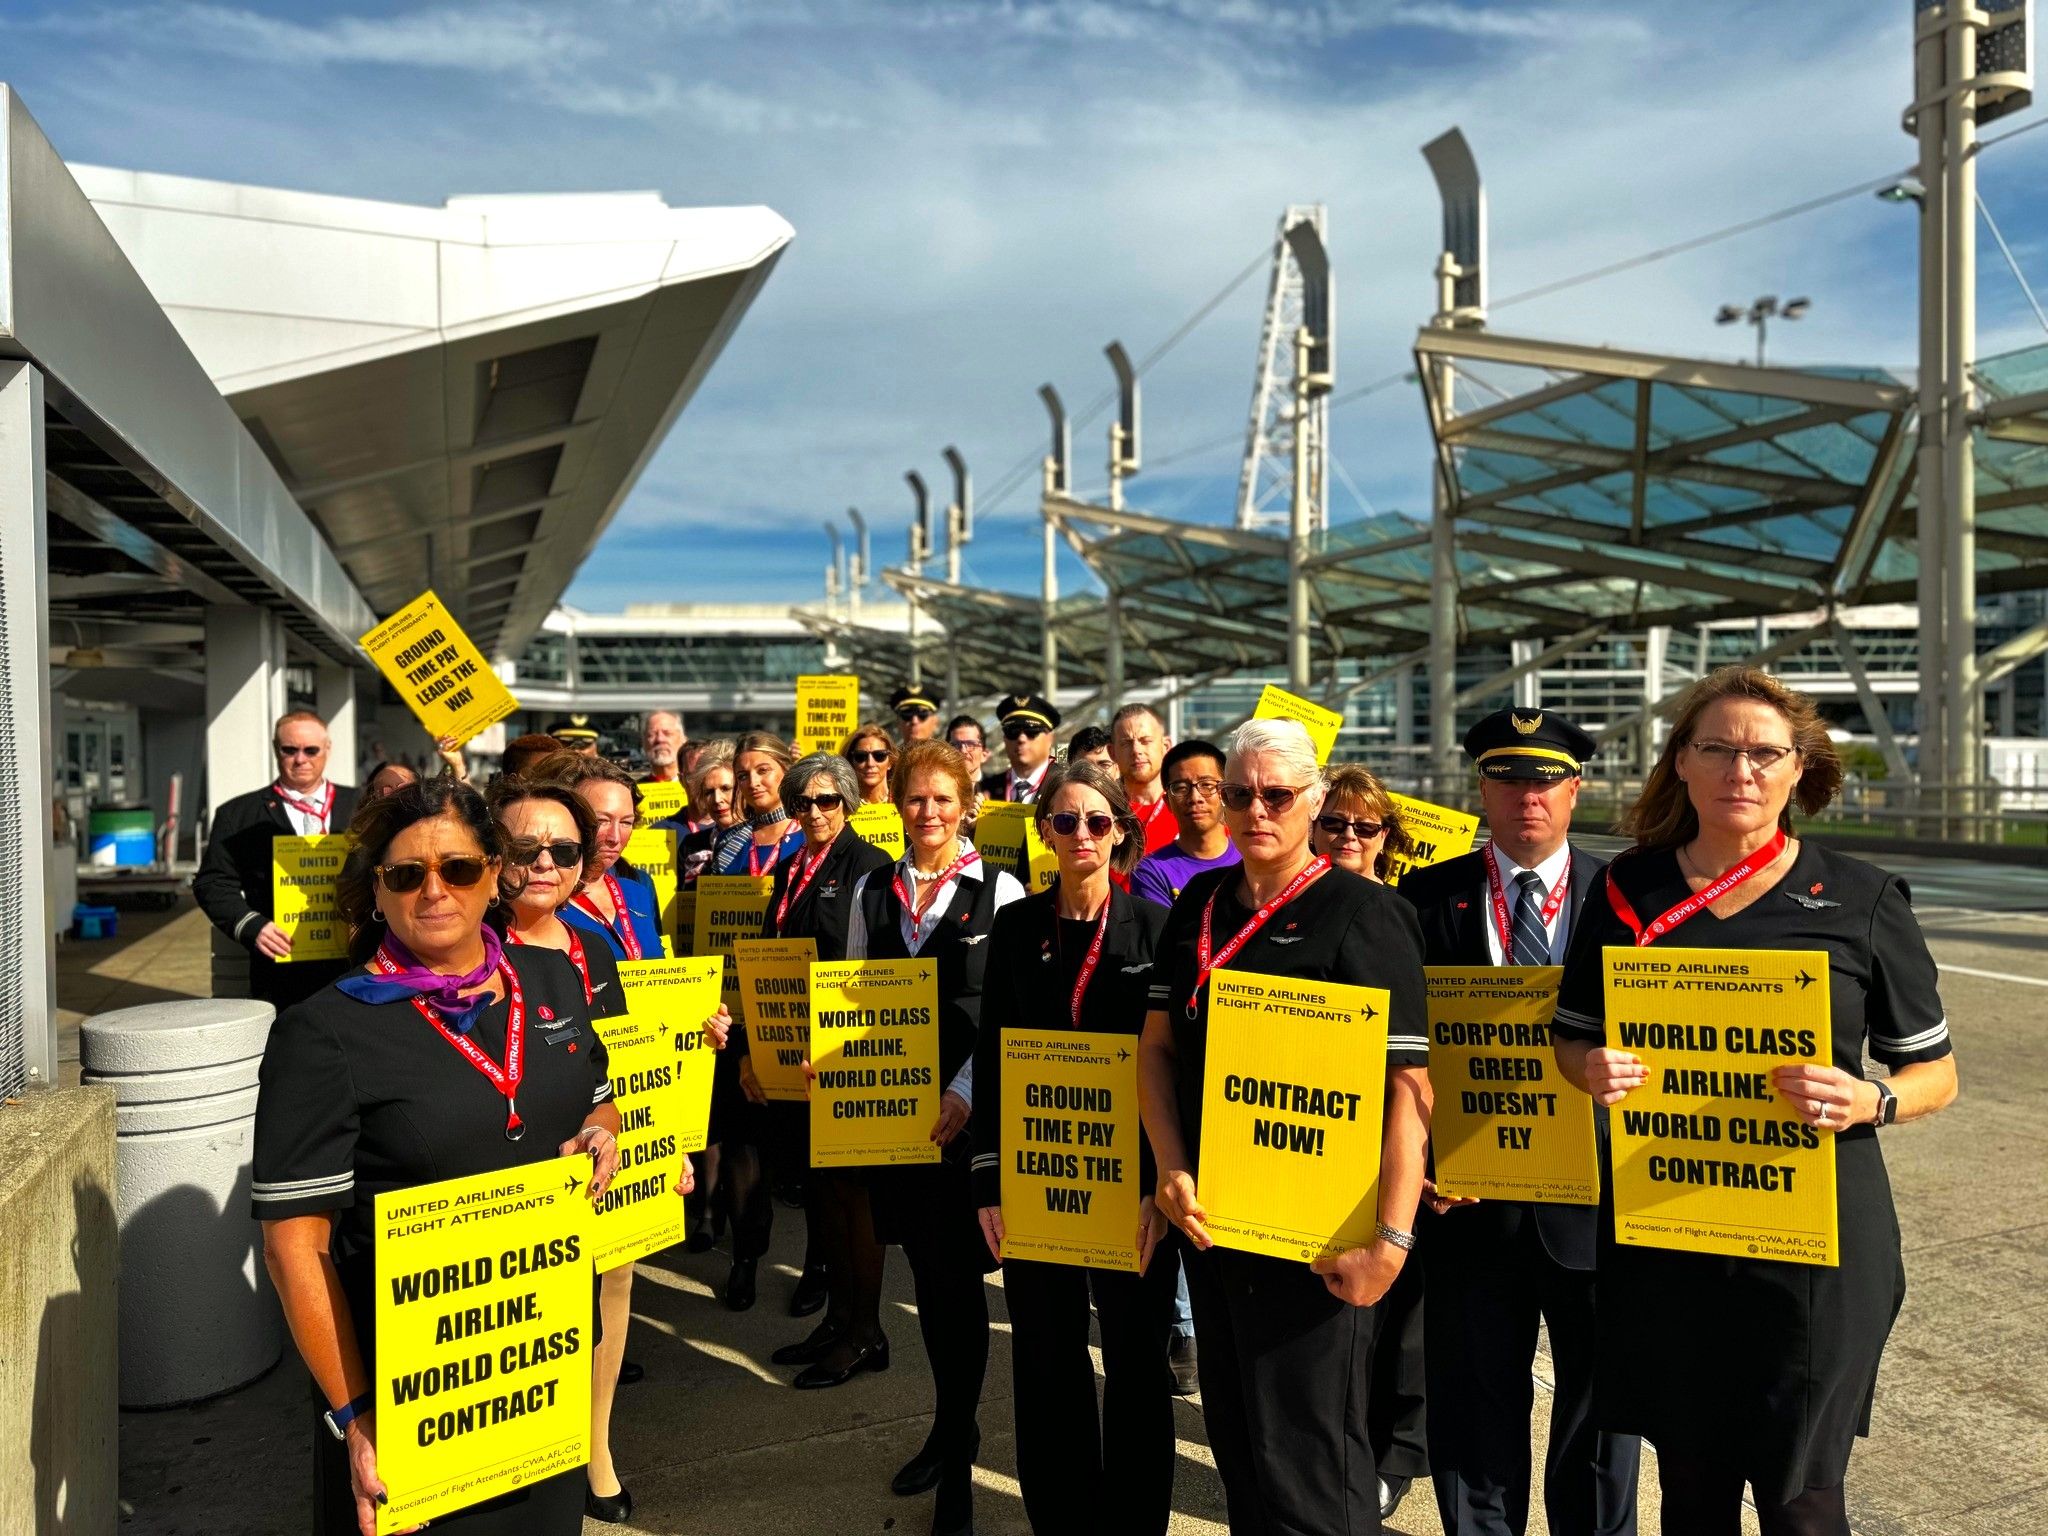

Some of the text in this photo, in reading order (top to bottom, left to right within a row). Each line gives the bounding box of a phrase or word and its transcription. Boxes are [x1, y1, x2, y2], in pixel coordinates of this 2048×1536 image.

[394, 629, 447, 669] GROUND
[406, 644, 460, 686] TIME PAY
[416, 659, 479, 707] LEADS THE
[444, 686, 475, 713] WAY
[808, 698, 846, 709] GROUND
[807, 712, 847, 723] TIME PAY
[803, 726, 850, 737] LEADS THE
[816, 740, 836, 750] WAY
[649, 800, 681, 810] UNITED
[1404, 806, 1441, 820] AIRLINES
[869, 832, 899, 844] CLASS
[299, 857, 338, 867] UNITED
[1270, 897, 1284, 908] NO
[1283, 876, 1305, 897] MORE
[1666, 865, 1753, 924] WHATEVER IT TAKES
[711, 911, 763, 926] GROUND
[310, 929, 331, 940] EGO
[1205, 921, 1257, 971] CONTRACT NOW!
[649, 966, 687, 976] AIRLINES
[816, 968, 895, 978] UNITED AIRLINES
[1613, 962, 1750, 975] UNITED AIRLINES
[646, 976, 702, 987] ATTENDANTS
[755, 978, 806, 995] GROUND
[816, 979, 913, 989] FLIGHT ATTENDANTS
[1470, 978, 1524, 986] AIRLINES
[1614, 978, 1784, 994] FLIGHT ATTENDANTS
[1217, 982, 1326, 1004] UNITED AIRLINES
[1425, 990, 1550, 999] FLIGHT ATTENDANTS
[756, 1001, 787, 1018] TIME
[818, 1007, 930, 1029] WORLD CLASS
[1216, 997, 1352, 1023] FLIGHT ATTENDANTS
[602, 1025, 639, 1038] AIRLINES
[607, 1035, 655, 1050] TTENDANTS
[756, 1026, 794, 1042] LEADS
[1619, 1021, 1817, 1057] WORLD CLASS
[508, 1008, 521, 1080] CONTRACT NOW!
[842, 1038, 907, 1058] AIRLINE,
[1007, 1039, 1090, 1051] UNITED AIRLINES
[1007, 1051, 1111, 1065] FLIGHT ATTENDANTS
[483, 1061, 505, 1082] NOW!
[630, 1066, 671, 1095] CLASS
[818, 1067, 932, 1089] WORLD CLASS
[1469, 1057, 1543, 1082] GREED
[1662, 1069, 1775, 1103] AIRLINE,
[832, 1098, 919, 1119] CONTRACT
[1025, 1083, 1112, 1113] GROUND
[1224, 1074, 1361, 1122] CONTRACT
[1461, 1091, 1557, 1117] DOESN'T
[1023, 1117, 1115, 1147] TIME PAY
[1253, 1118, 1325, 1156] NOW!
[1497, 1126, 1532, 1150] FLY
[1623, 1110, 1820, 1149] WORLD CLASS
[634, 1135, 676, 1166] CLASS
[1017, 1150, 1123, 1183] LEADS THE
[1649, 1155, 1796, 1193] CONTRACT
[1444, 1178, 1479, 1187] Association
[387, 1183, 525, 1220] UNITED AIRLINES
[594, 1173, 667, 1216] CONTRACT
[1046, 1187, 1092, 1215] WAY
[387, 1194, 555, 1239] FLIGHT ATTENDANTS
[1203, 1221, 1270, 1242] Association of Flight
[1624, 1221, 1672, 1235] Association
[1674, 1225, 1683, 1234] of
[1685, 1226, 1707, 1238] Flight
[1760, 1244, 1827, 1261] UnitedAFA.org
[391, 1235, 580, 1306] WORLD CLASS
[435, 1292, 542, 1345] AIRLINE,
[391, 1327, 580, 1406] WORLD CLASS
[417, 1379, 559, 1447] CONTRACT
[523, 1454, 582, 1480] UnitedAFA.org
[388, 1492, 438, 1515] Association
[440, 1487, 450, 1497] of
[451, 1480, 474, 1493] Flight
